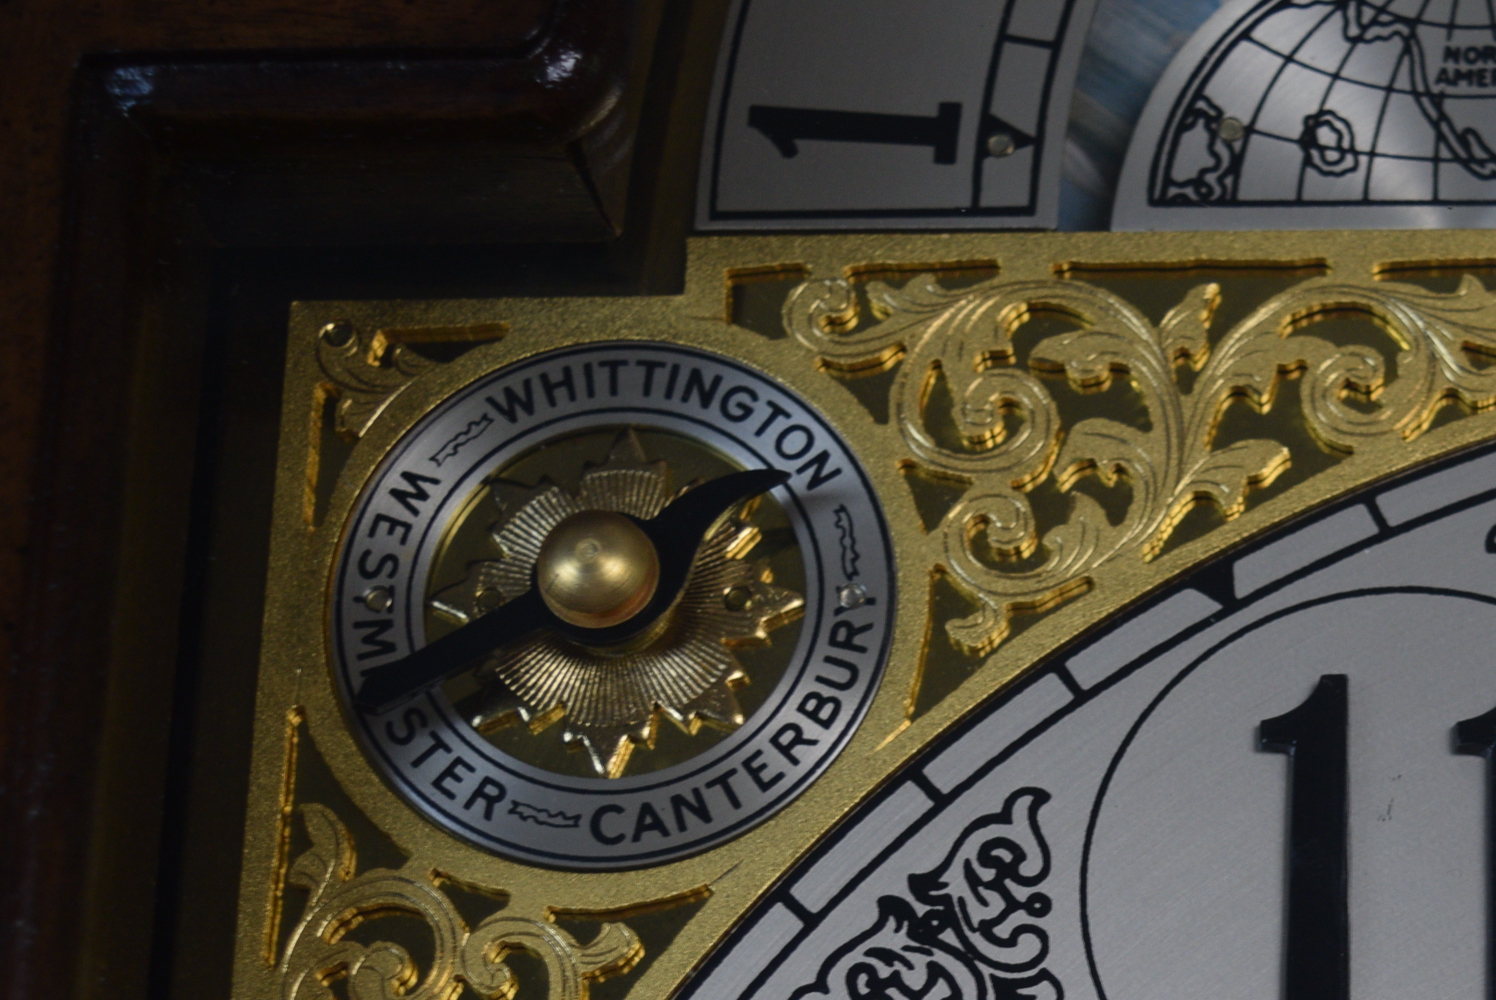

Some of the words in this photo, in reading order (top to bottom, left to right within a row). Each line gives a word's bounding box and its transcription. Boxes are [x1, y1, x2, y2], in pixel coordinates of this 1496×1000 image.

[748, 101, 962, 165] 1
[484, 359, 841, 491] WHITTINGTON
[352, 469, 508, 820] WESTMSTER
